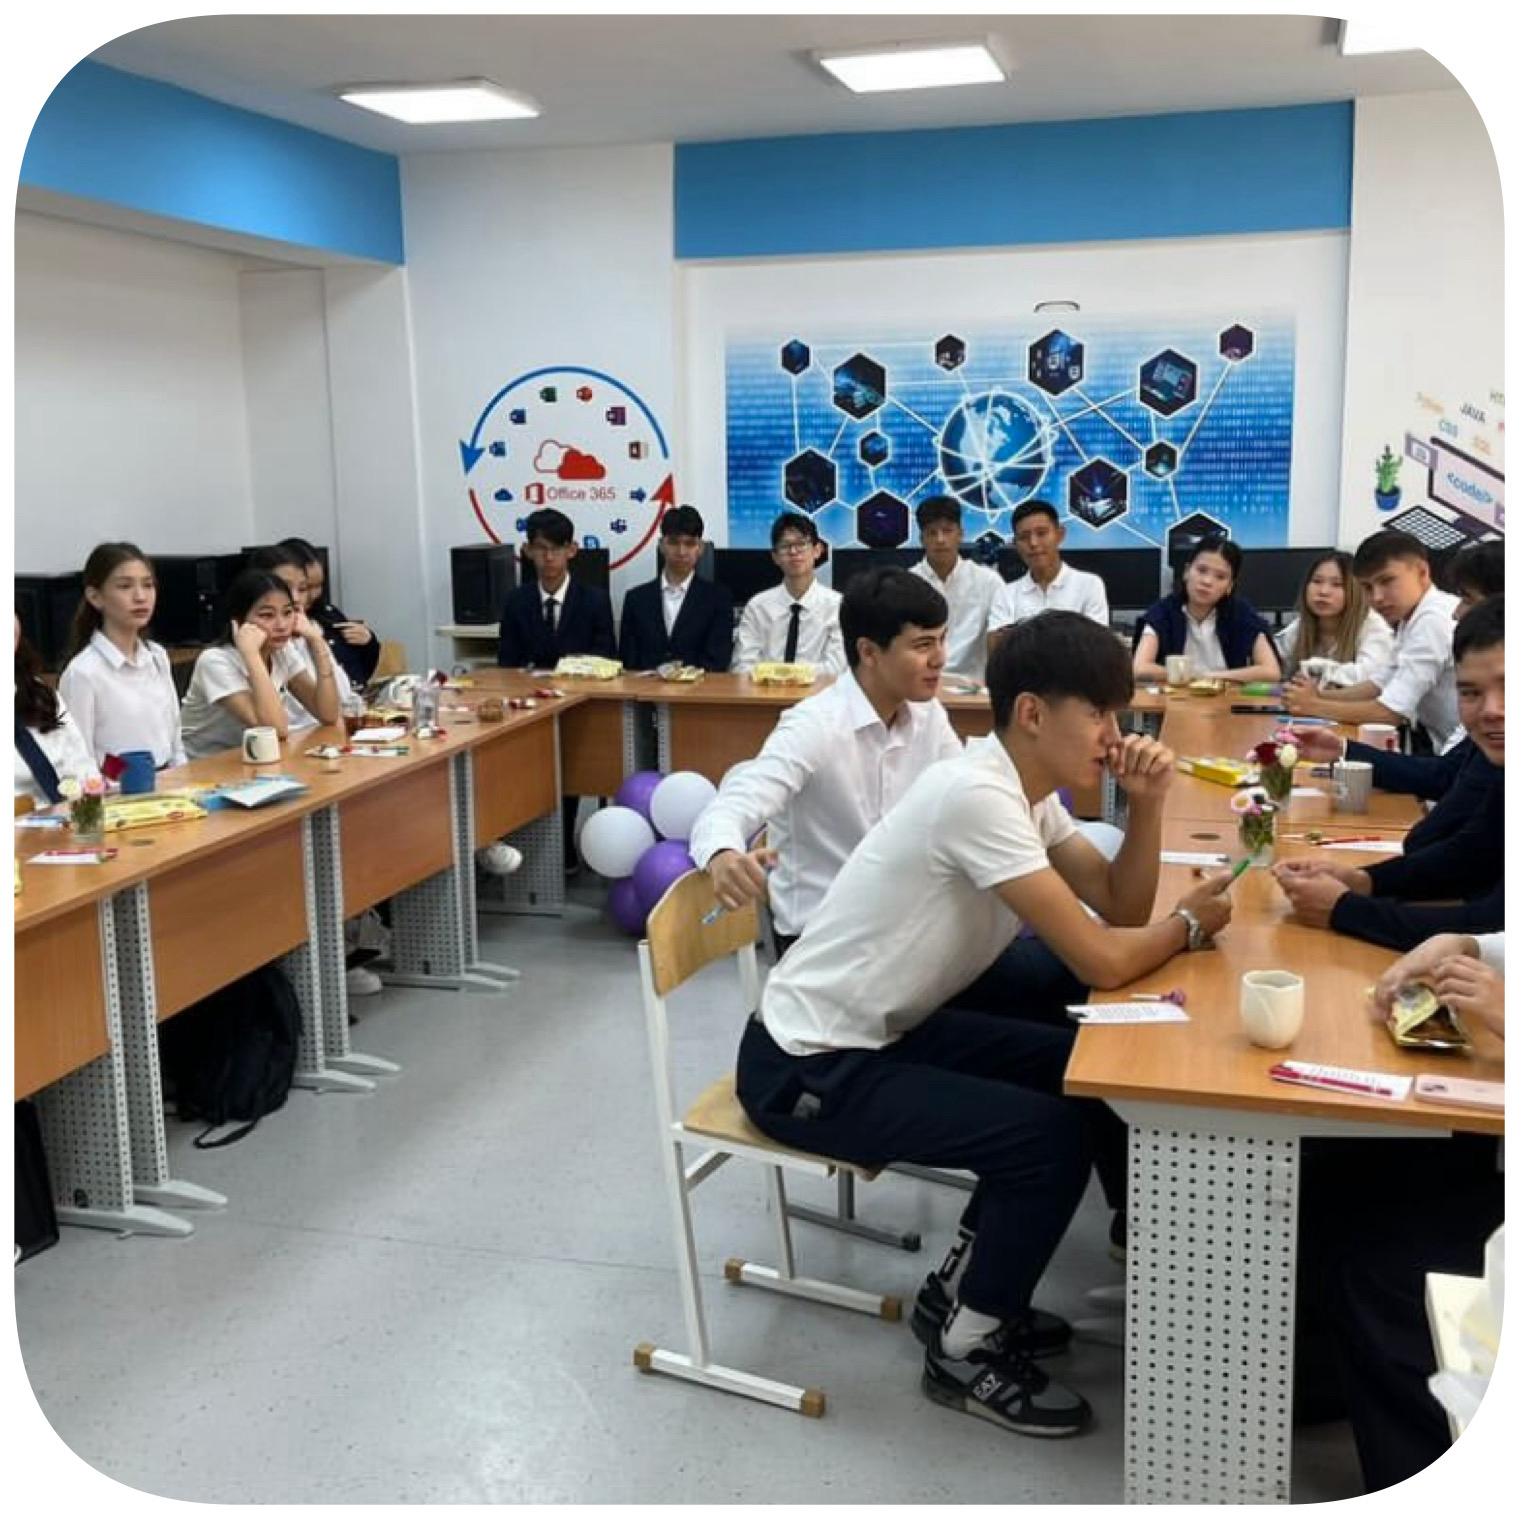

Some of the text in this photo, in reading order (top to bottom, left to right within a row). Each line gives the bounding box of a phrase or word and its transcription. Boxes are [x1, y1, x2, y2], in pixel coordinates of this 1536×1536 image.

[1459, 403, 1486, 424] JAVA
[547, 486, 616, 500] Office 365
